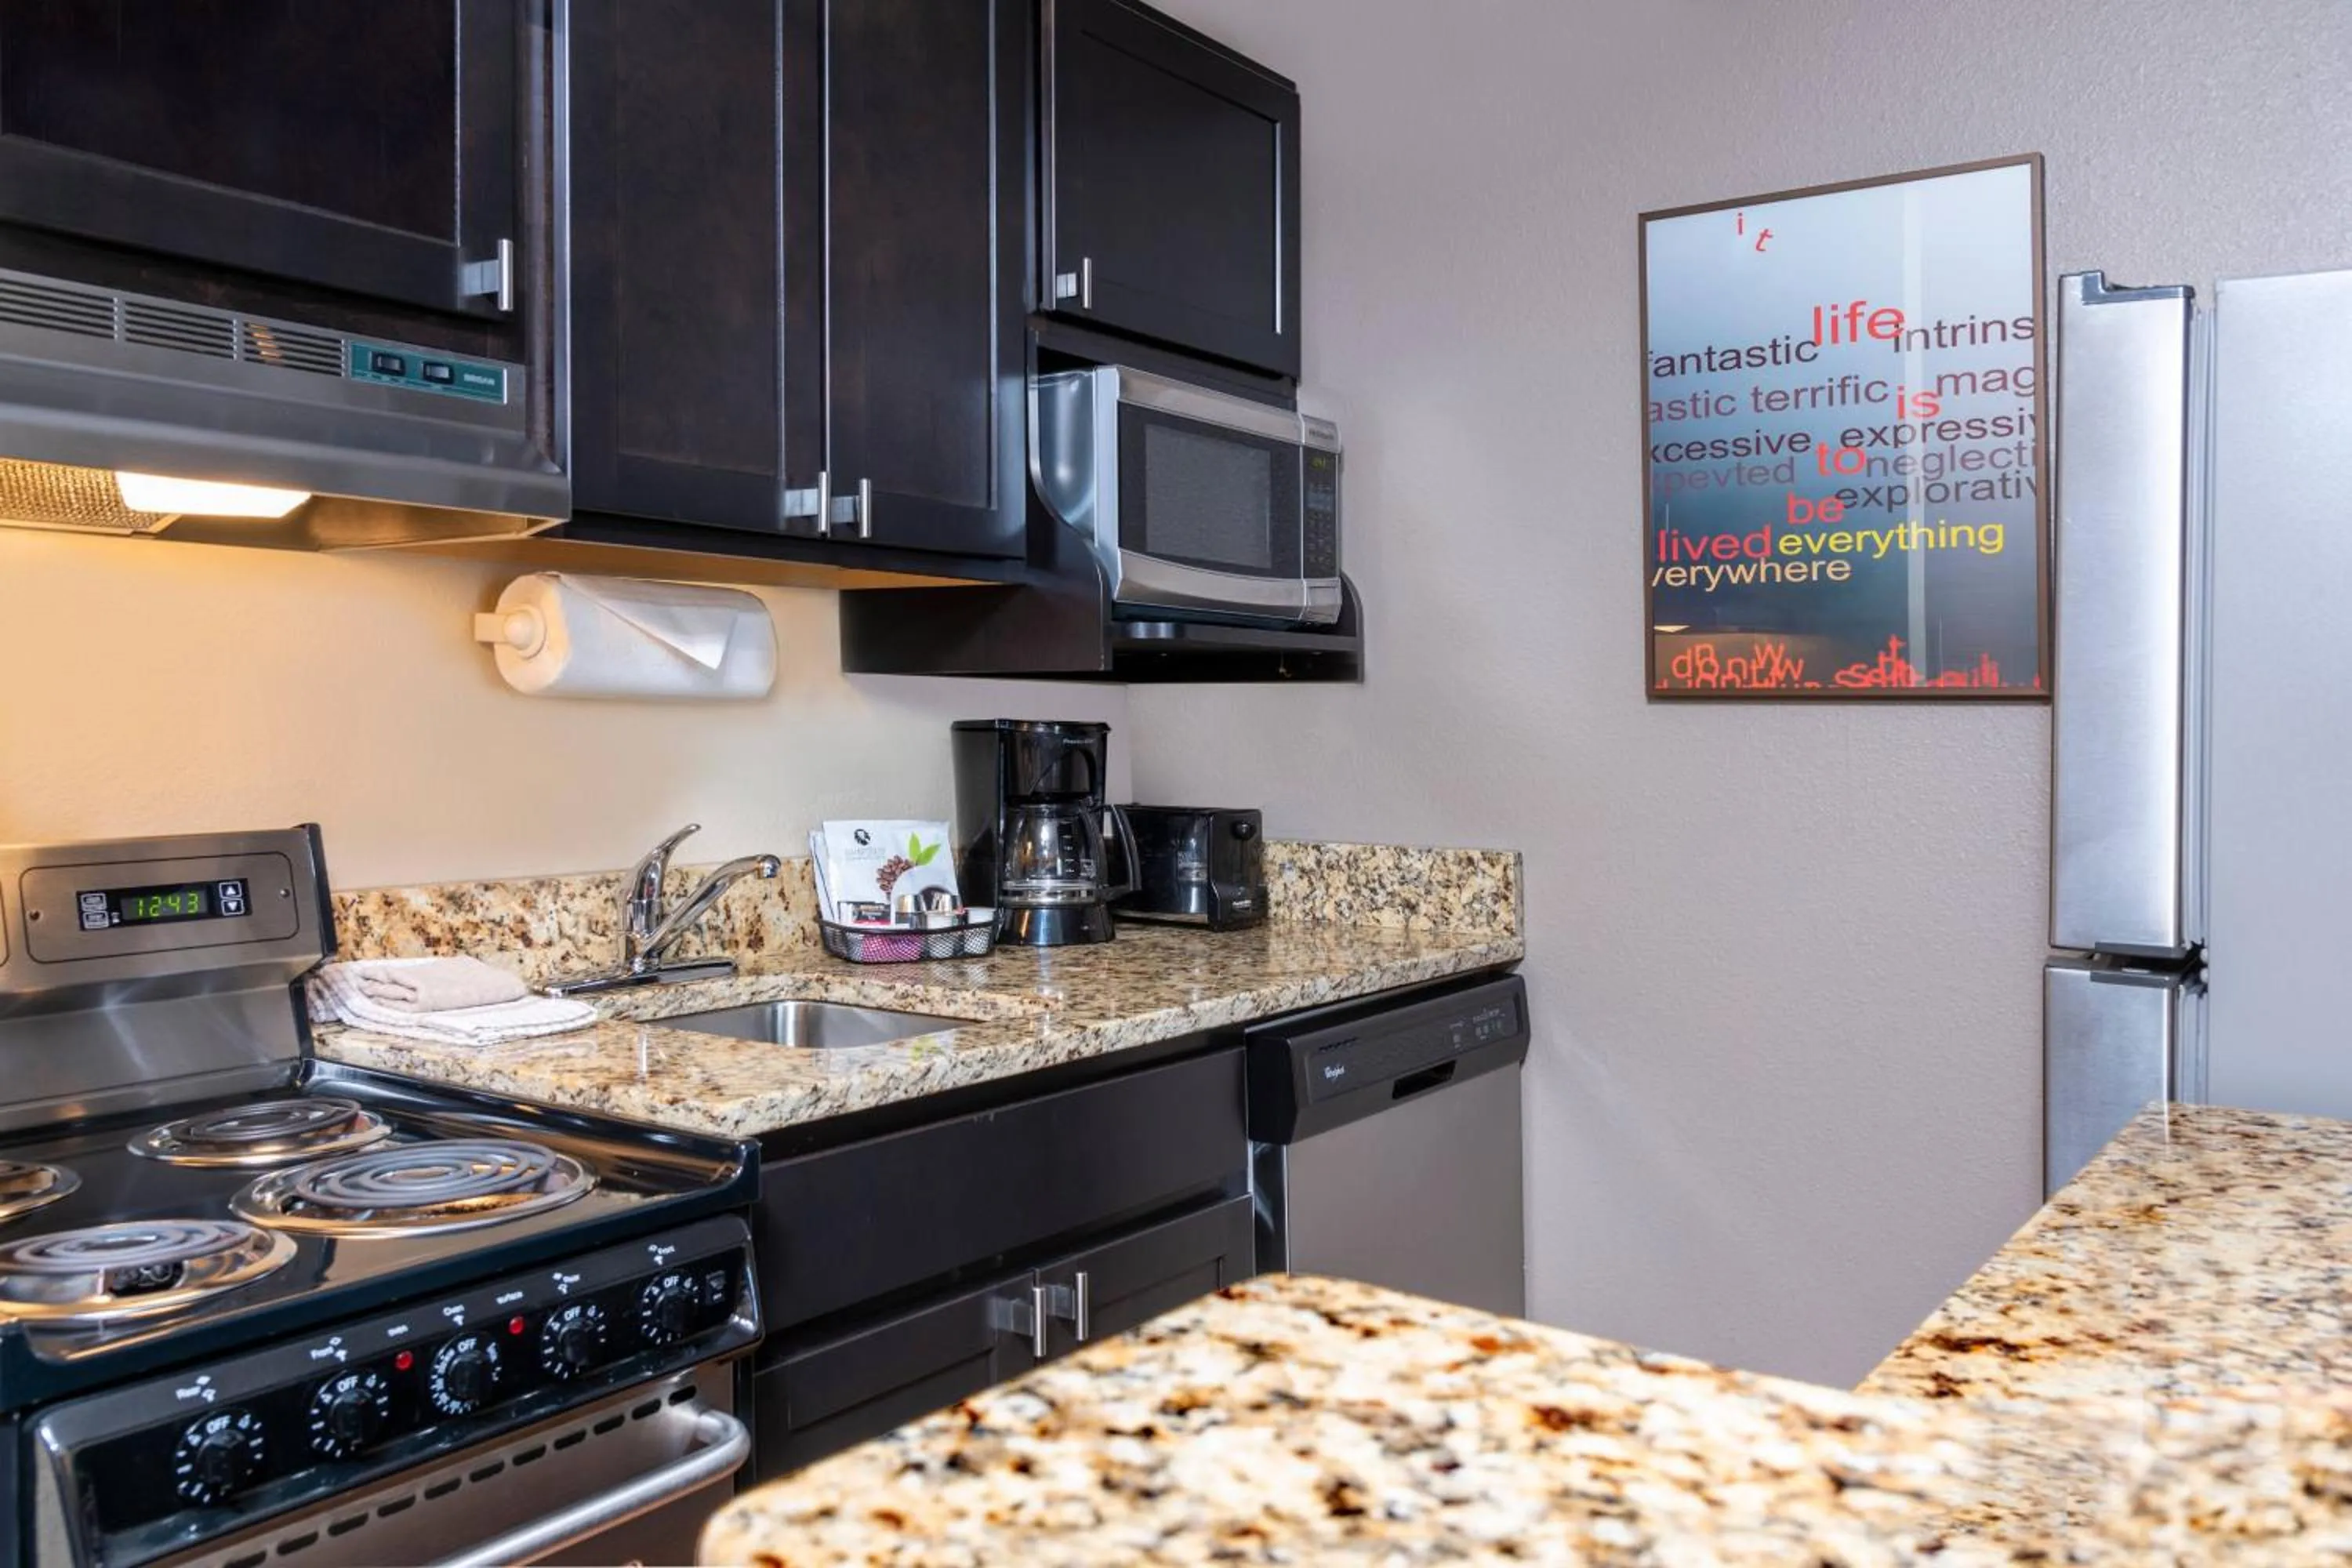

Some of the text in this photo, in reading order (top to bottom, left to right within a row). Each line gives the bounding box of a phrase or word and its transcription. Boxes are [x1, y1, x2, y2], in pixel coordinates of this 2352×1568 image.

[1813, 300, 1905, 347] life
[1751, 376, 1889, 413] terrific
[1897, 385, 1941, 419] is
[1816, 442, 1866, 477] to
[1787, 492, 1845, 524] be
[1658, 519, 2005, 563] lived everything
